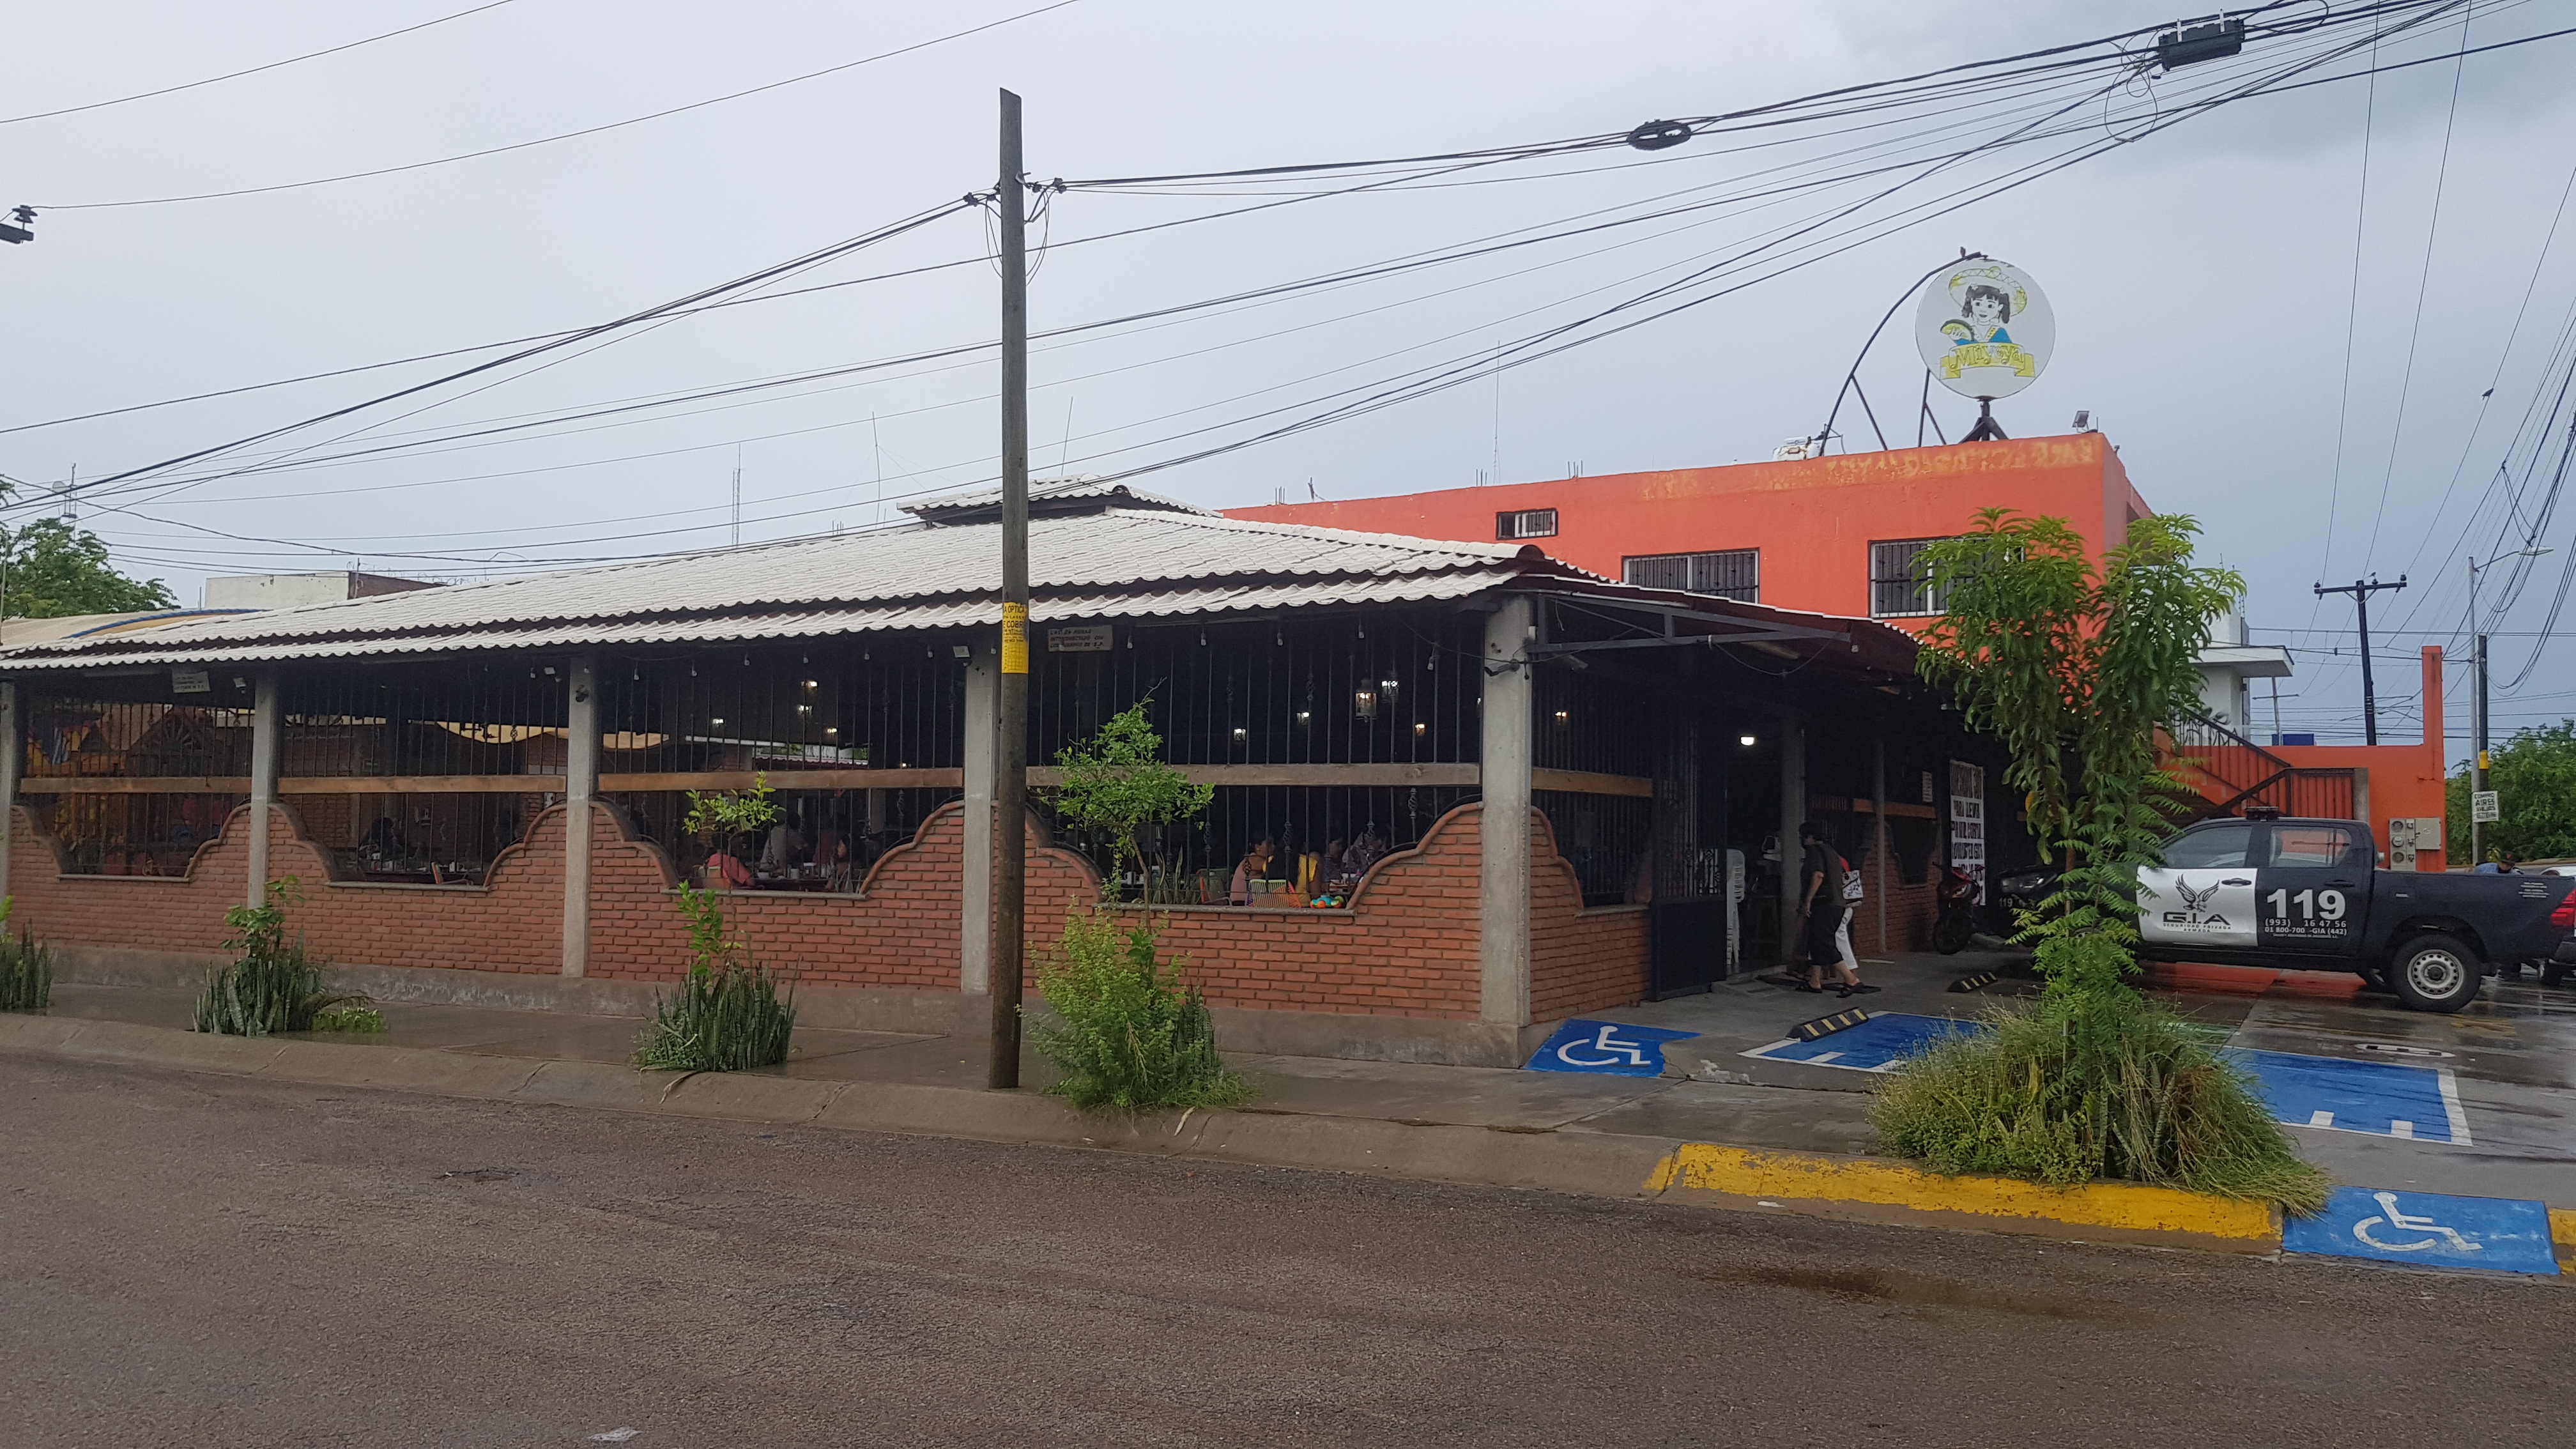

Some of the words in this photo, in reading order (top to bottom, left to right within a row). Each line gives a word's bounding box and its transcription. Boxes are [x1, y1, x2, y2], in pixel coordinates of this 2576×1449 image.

[2475, 798, 2495, 806] AIRES
[1999, 897, 2013, 908] 119
[2267, 889, 2346, 920] 119
[2265, 918, 2291, 927] (993)
